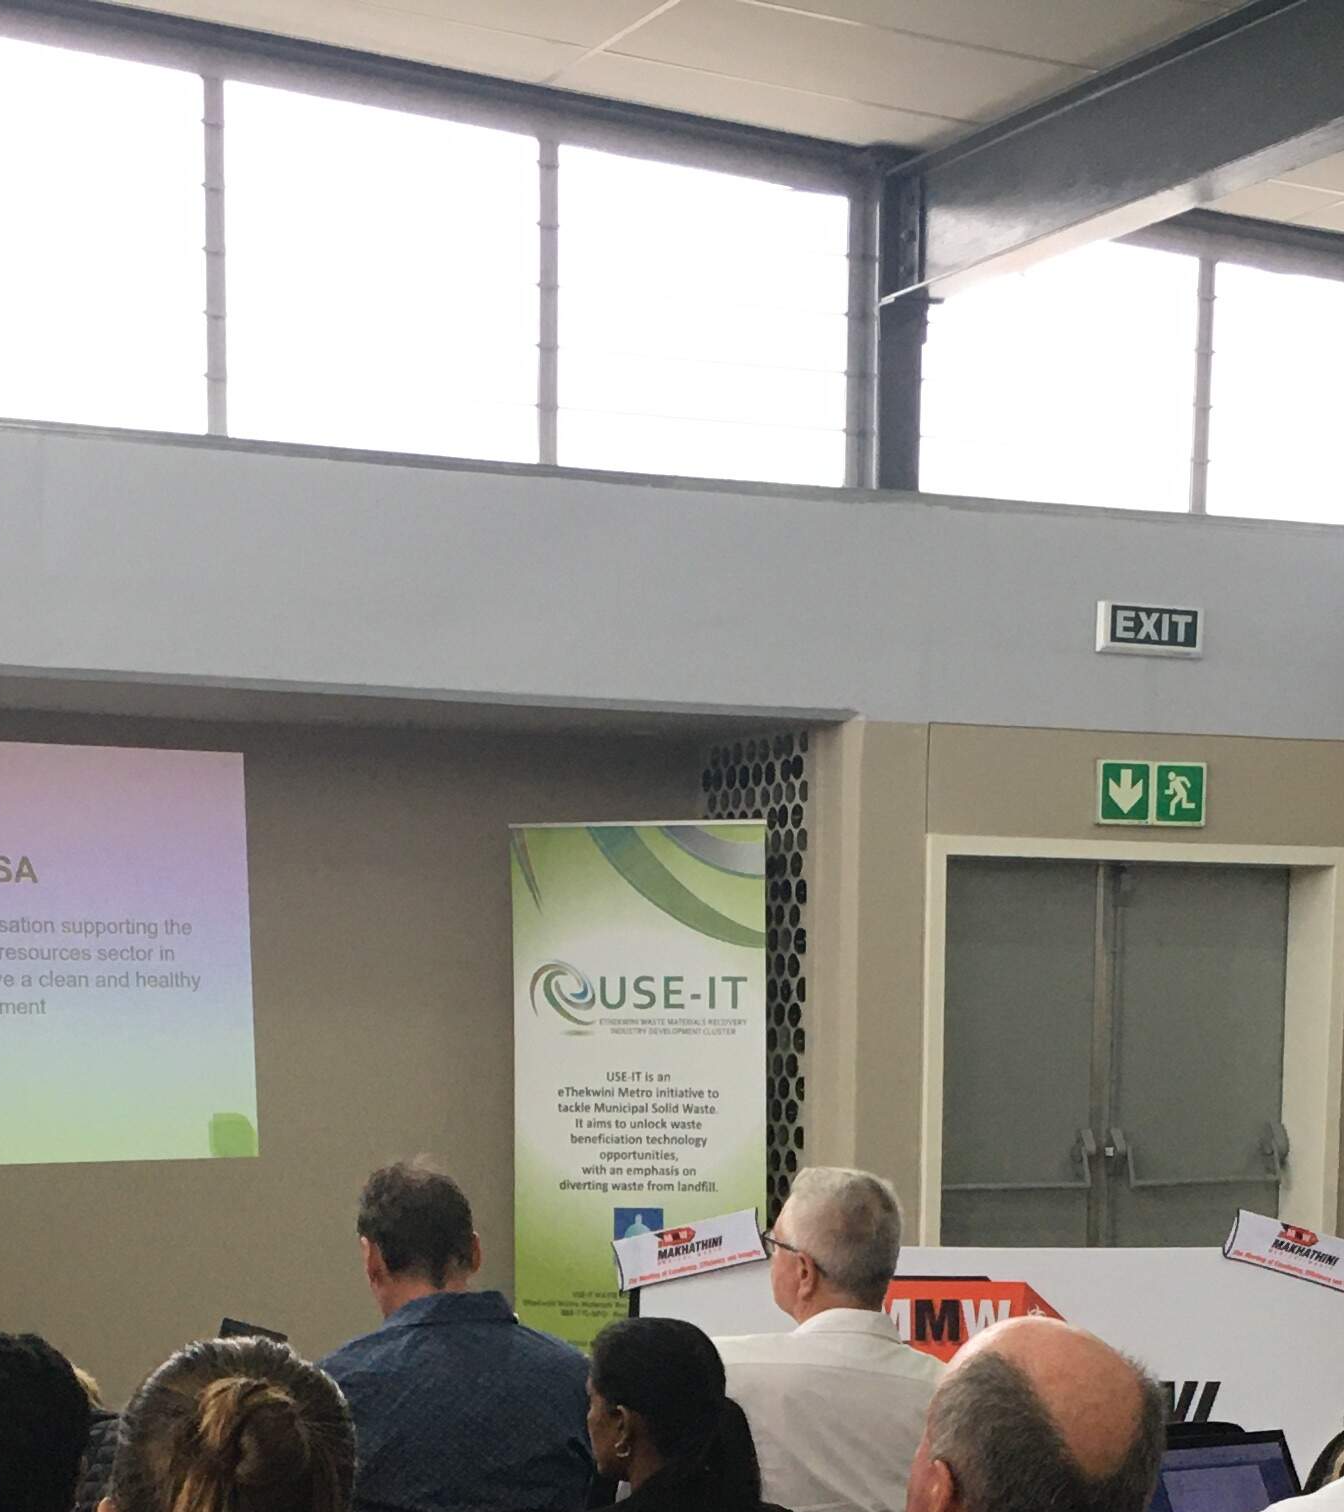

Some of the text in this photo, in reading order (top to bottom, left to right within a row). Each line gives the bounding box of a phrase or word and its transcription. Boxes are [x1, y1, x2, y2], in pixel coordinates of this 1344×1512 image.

[1116, 610, 1192, 642] EXIT
[61, 917, 158, 938] supporting
[165, 918, 193, 935] the
[97, 944, 154, 962] sector
[160, 944, 175, 962] in
[21, 974, 32, 988] a
[39, 970, 89, 989] clean
[95, 971, 130, 989] and
[135, 971, 201, 993] healthy
[600, 976, 748, 1010] USE-IT
[606, 1071, 670, 1082] USE-IT is an
[558, 1087, 719, 1099] eThekwini Metro initiative to
[558, 1102, 590, 1113] tackle
[594, 1103, 648, 1115] Municipal
[652, 1103, 678, 1114] Solid
[576, 1119, 702, 1130] It aims to unlock waste
[570, 1134, 707, 1148] beneficiation technology
[599, 1150, 678, 1163] opportunities,
[582, 1165, 696, 1177] with an emphasis on
[559, 1180, 718, 1193] diverting waste from landfill.
[657, 1235, 723, 1260] MAKHATHINI
[1271, 1239, 1340, 1266] MAKHATHINI
